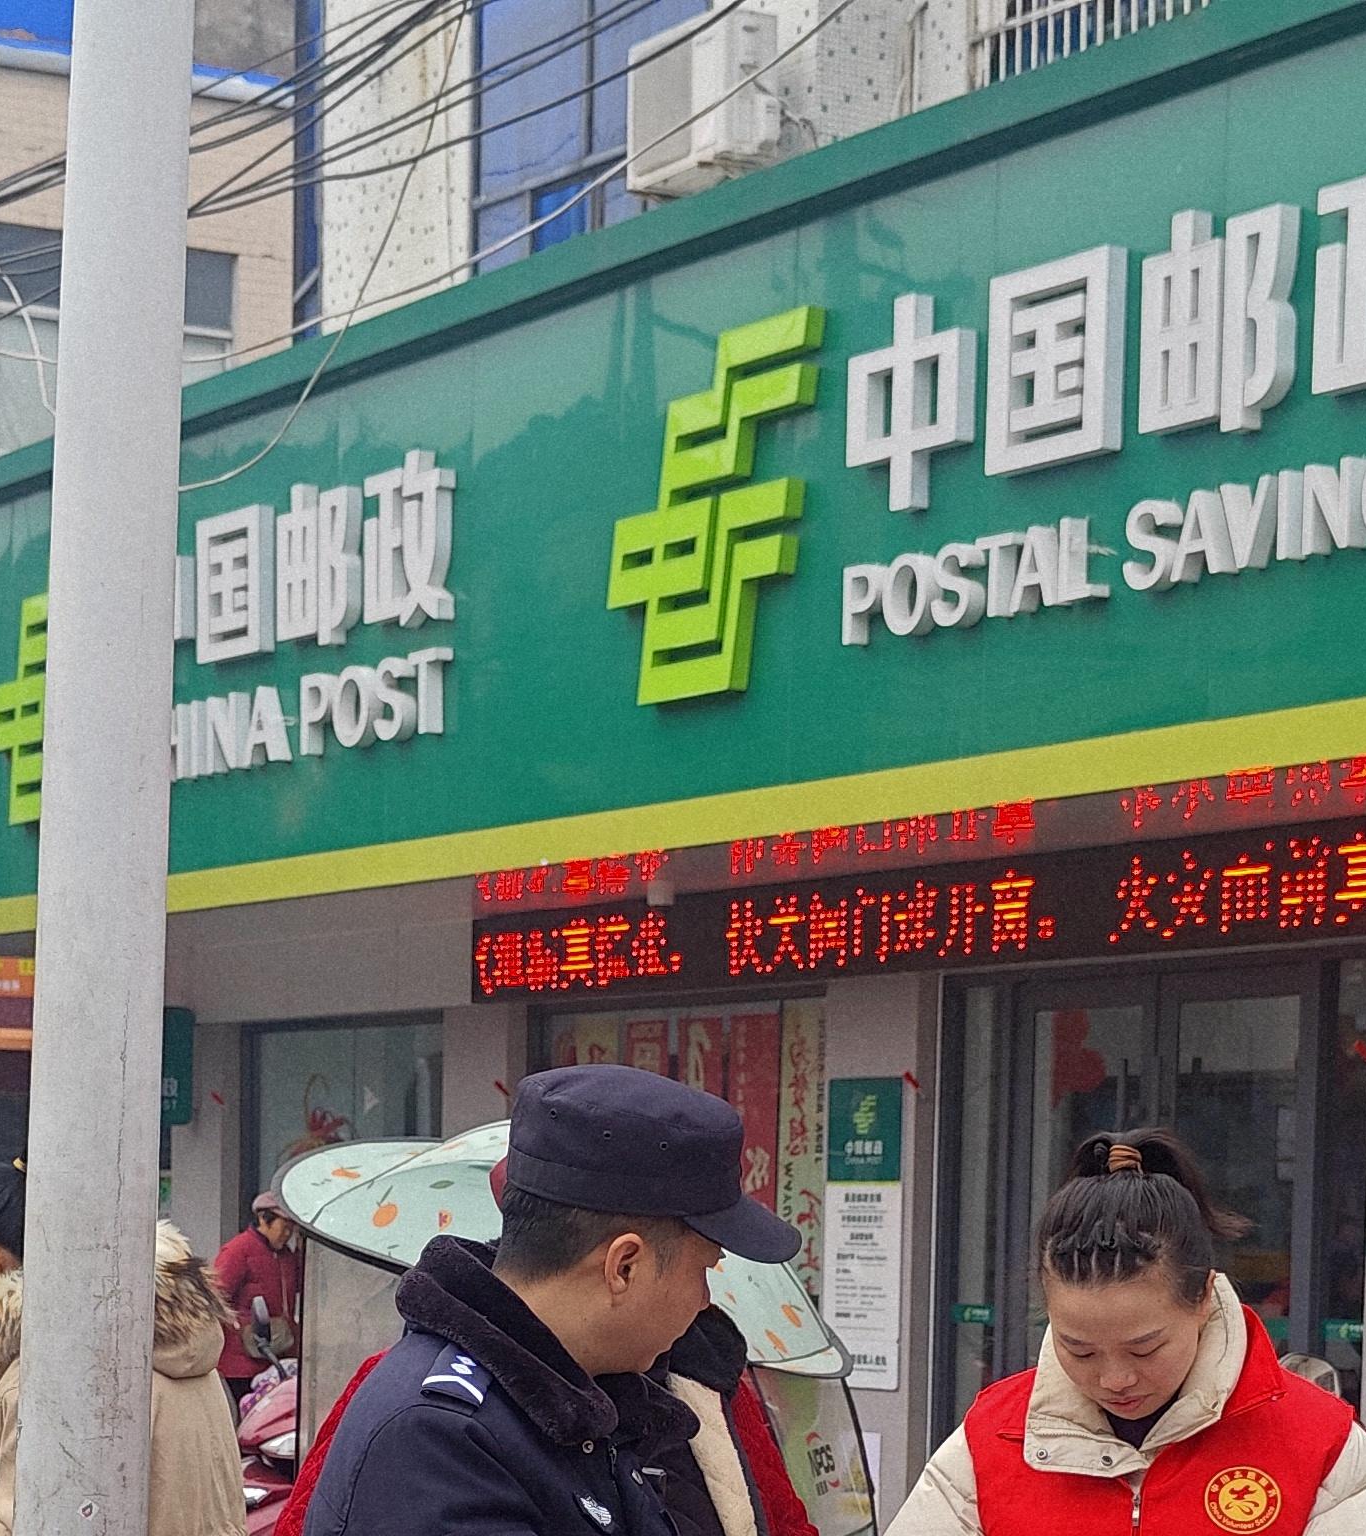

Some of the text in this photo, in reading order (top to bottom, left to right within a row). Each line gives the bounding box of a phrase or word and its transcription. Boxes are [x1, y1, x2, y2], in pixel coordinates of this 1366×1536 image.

[175, 449, 456, 664] 国邮政
[841, 515, 1113, 648] POSTAL
[300, 647, 454, 757] POST
